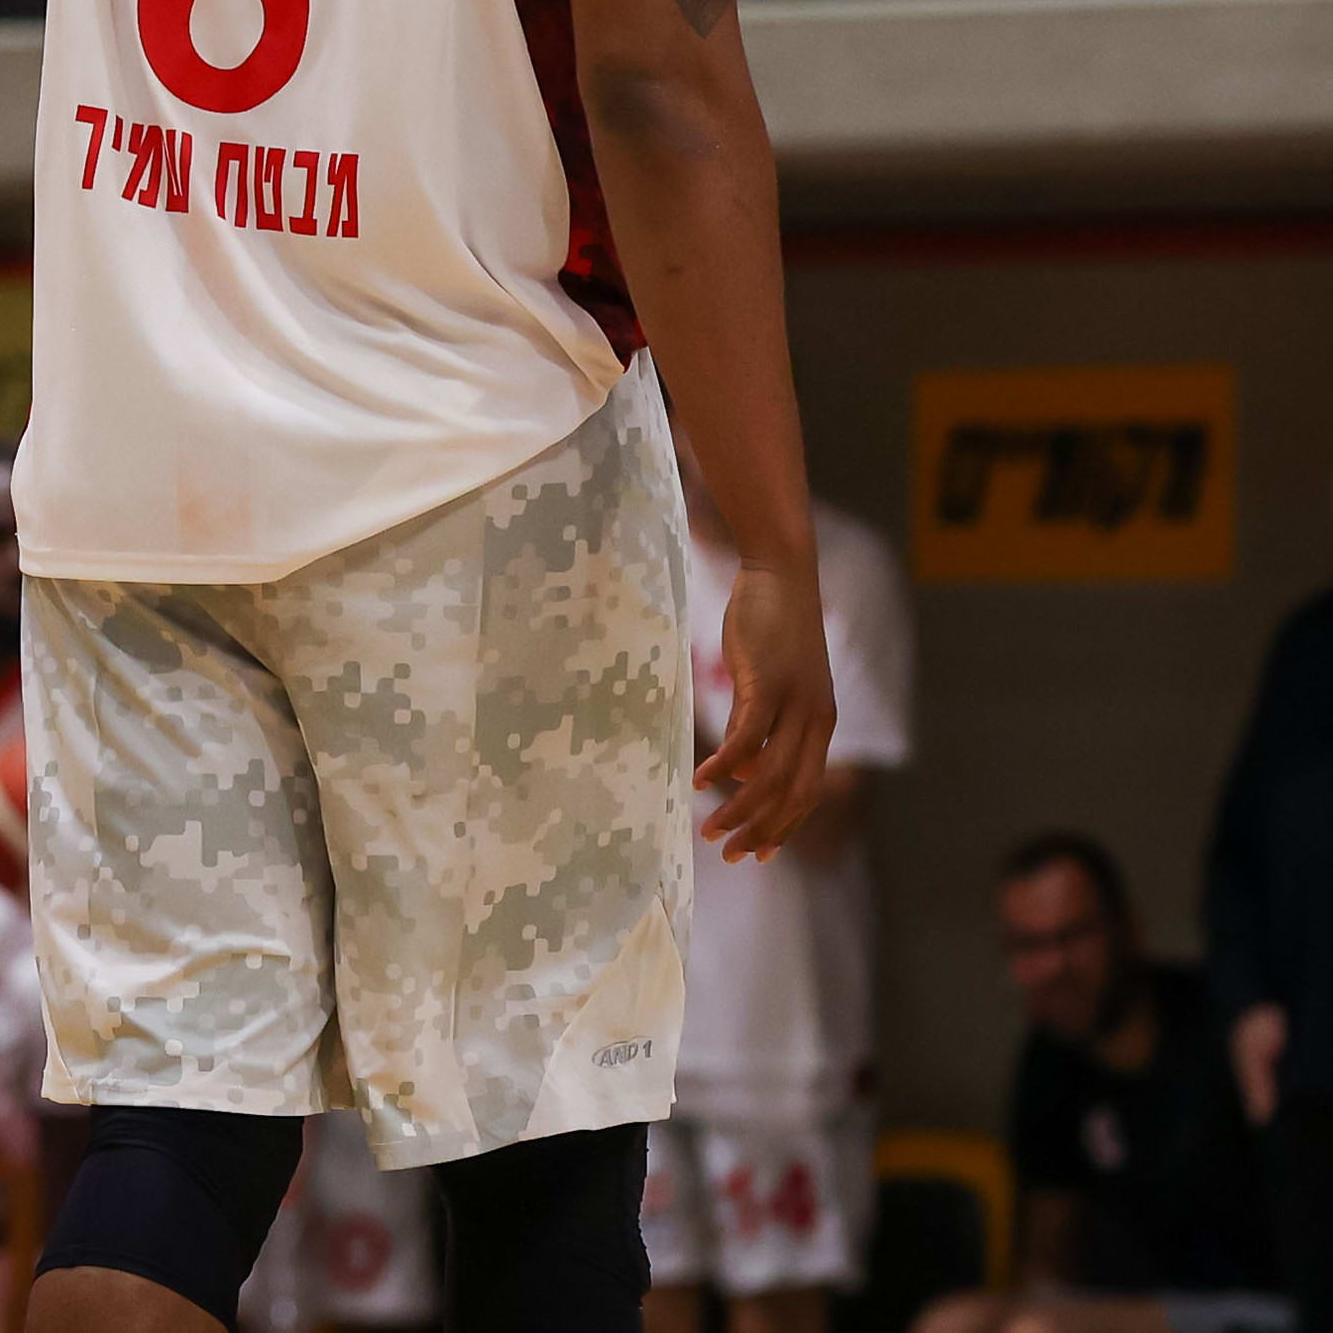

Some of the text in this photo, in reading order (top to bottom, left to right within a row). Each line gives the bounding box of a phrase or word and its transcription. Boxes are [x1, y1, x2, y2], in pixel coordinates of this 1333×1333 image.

[75, 104, 360, 239] מבטח שמיר
[598, 1039, 653, 1067] AND 1
